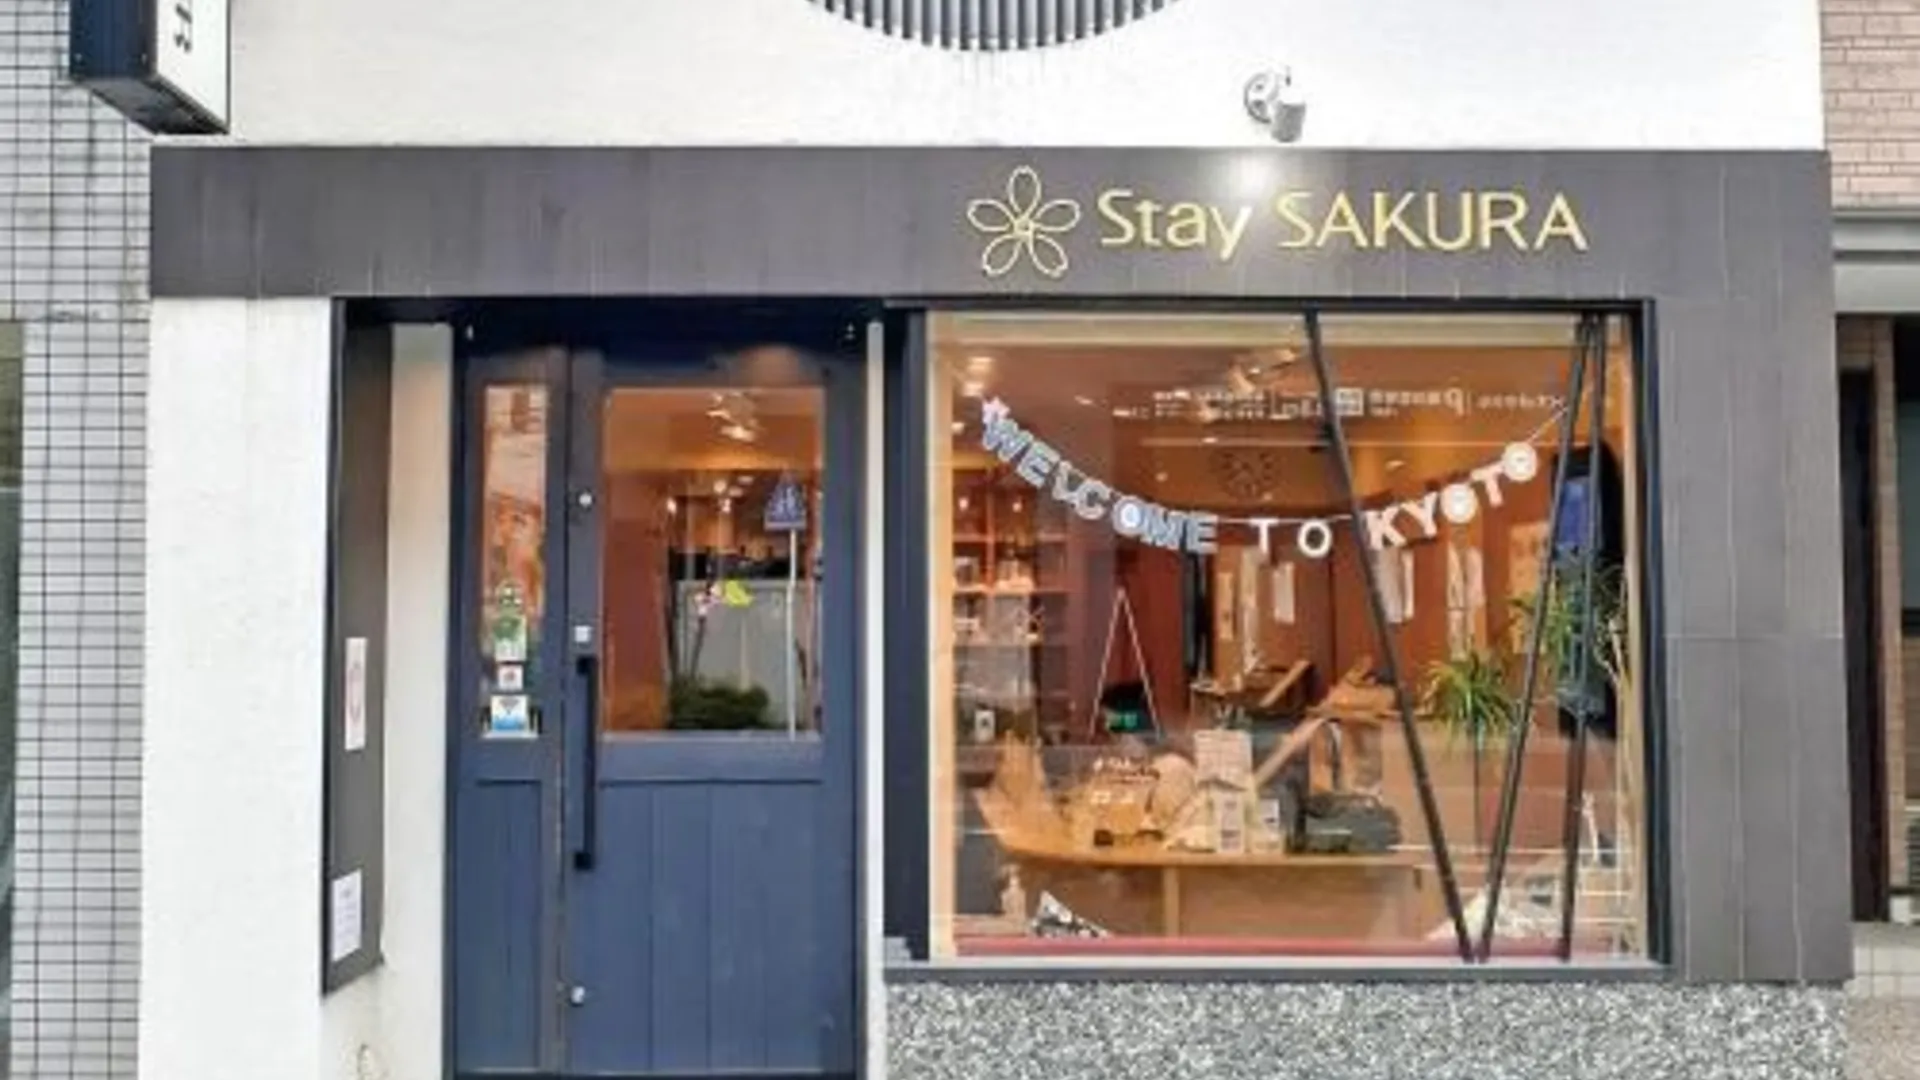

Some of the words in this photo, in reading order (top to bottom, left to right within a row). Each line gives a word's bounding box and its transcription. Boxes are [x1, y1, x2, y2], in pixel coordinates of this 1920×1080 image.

[1098, 188, 1252, 261] Stay
[1276, 189, 1588, 251] SAKURA
[982, 414, 1218, 553] WELCOME
[1250, 515, 1333, 558] TO
[1363, 441, 1538, 550] KYOTO
